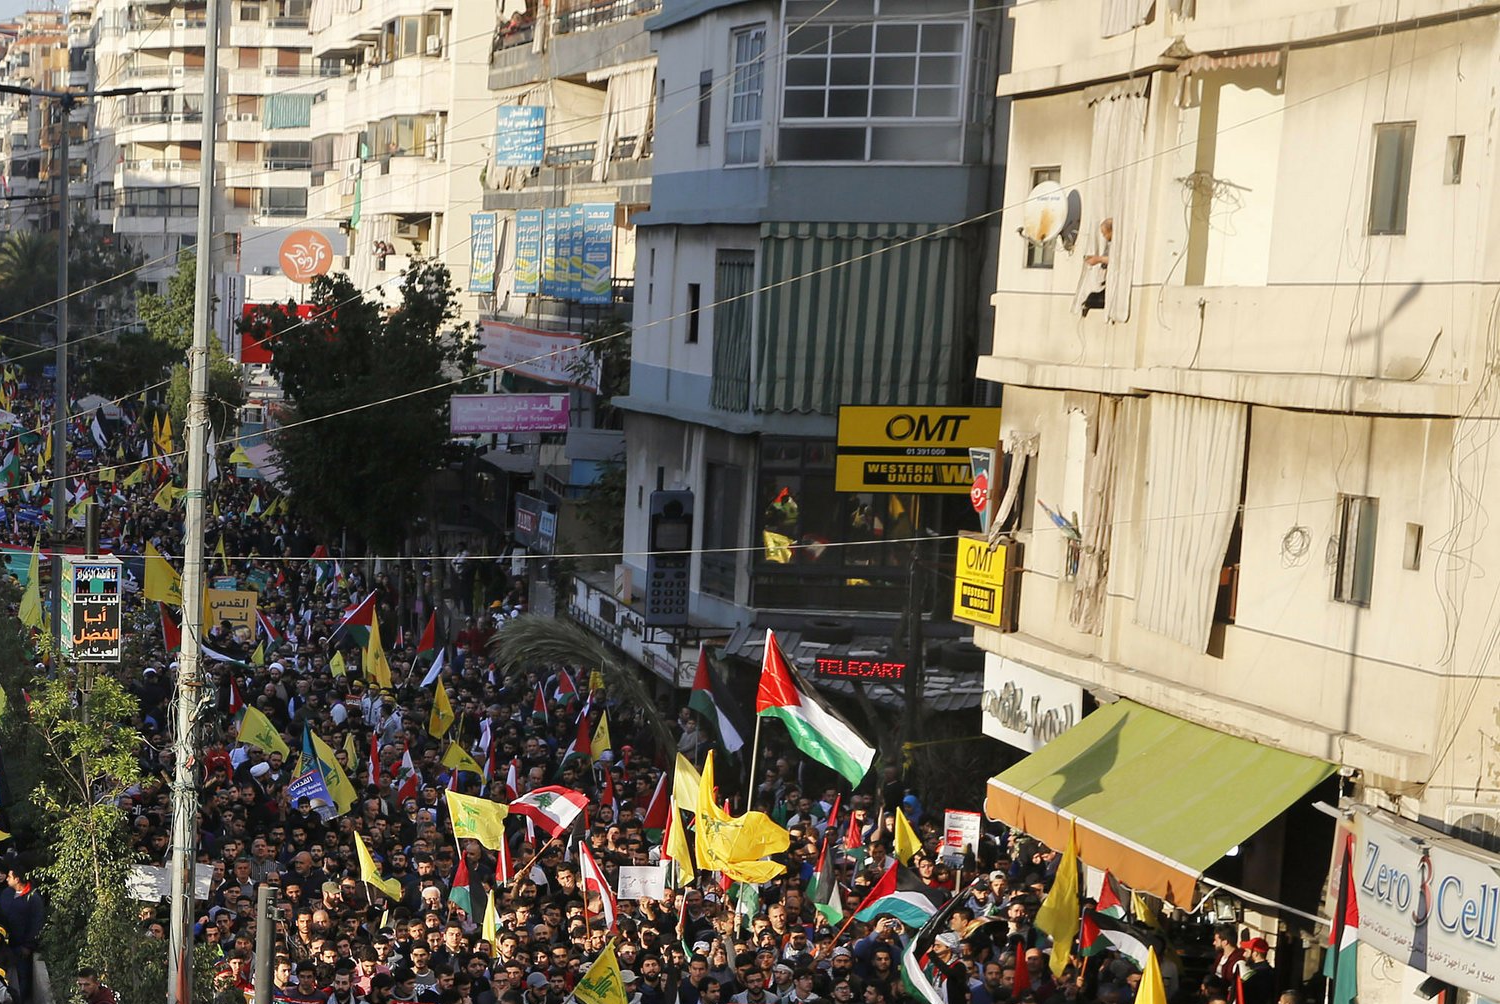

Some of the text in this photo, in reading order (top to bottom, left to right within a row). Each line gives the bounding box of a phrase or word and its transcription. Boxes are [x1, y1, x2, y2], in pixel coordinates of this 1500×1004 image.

[885, 414, 970, 442] OMT
[906, 448, 916, 456] 01
[867, 464, 934, 473] WESTERN
[888, 474, 933, 483] UNION
[966, 544, 996, 573] OMT
[962, 582, 990, 599] WESTERN
[74, 594, 119, 606] لبيك يا
[211, 598, 249, 609] القدس
[970, 597, 988, 610] UNION
[84, 606, 106, 625] أبا
[219, 611, 248, 621] لنا
[73, 628, 119, 645] الفضل
[816, 659, 906, 679] TELECART
[290, 775, 313, 792] القدس
[1361, 840, 1411, 909] Zero
[1437, 875, 1499, 945] Cell
